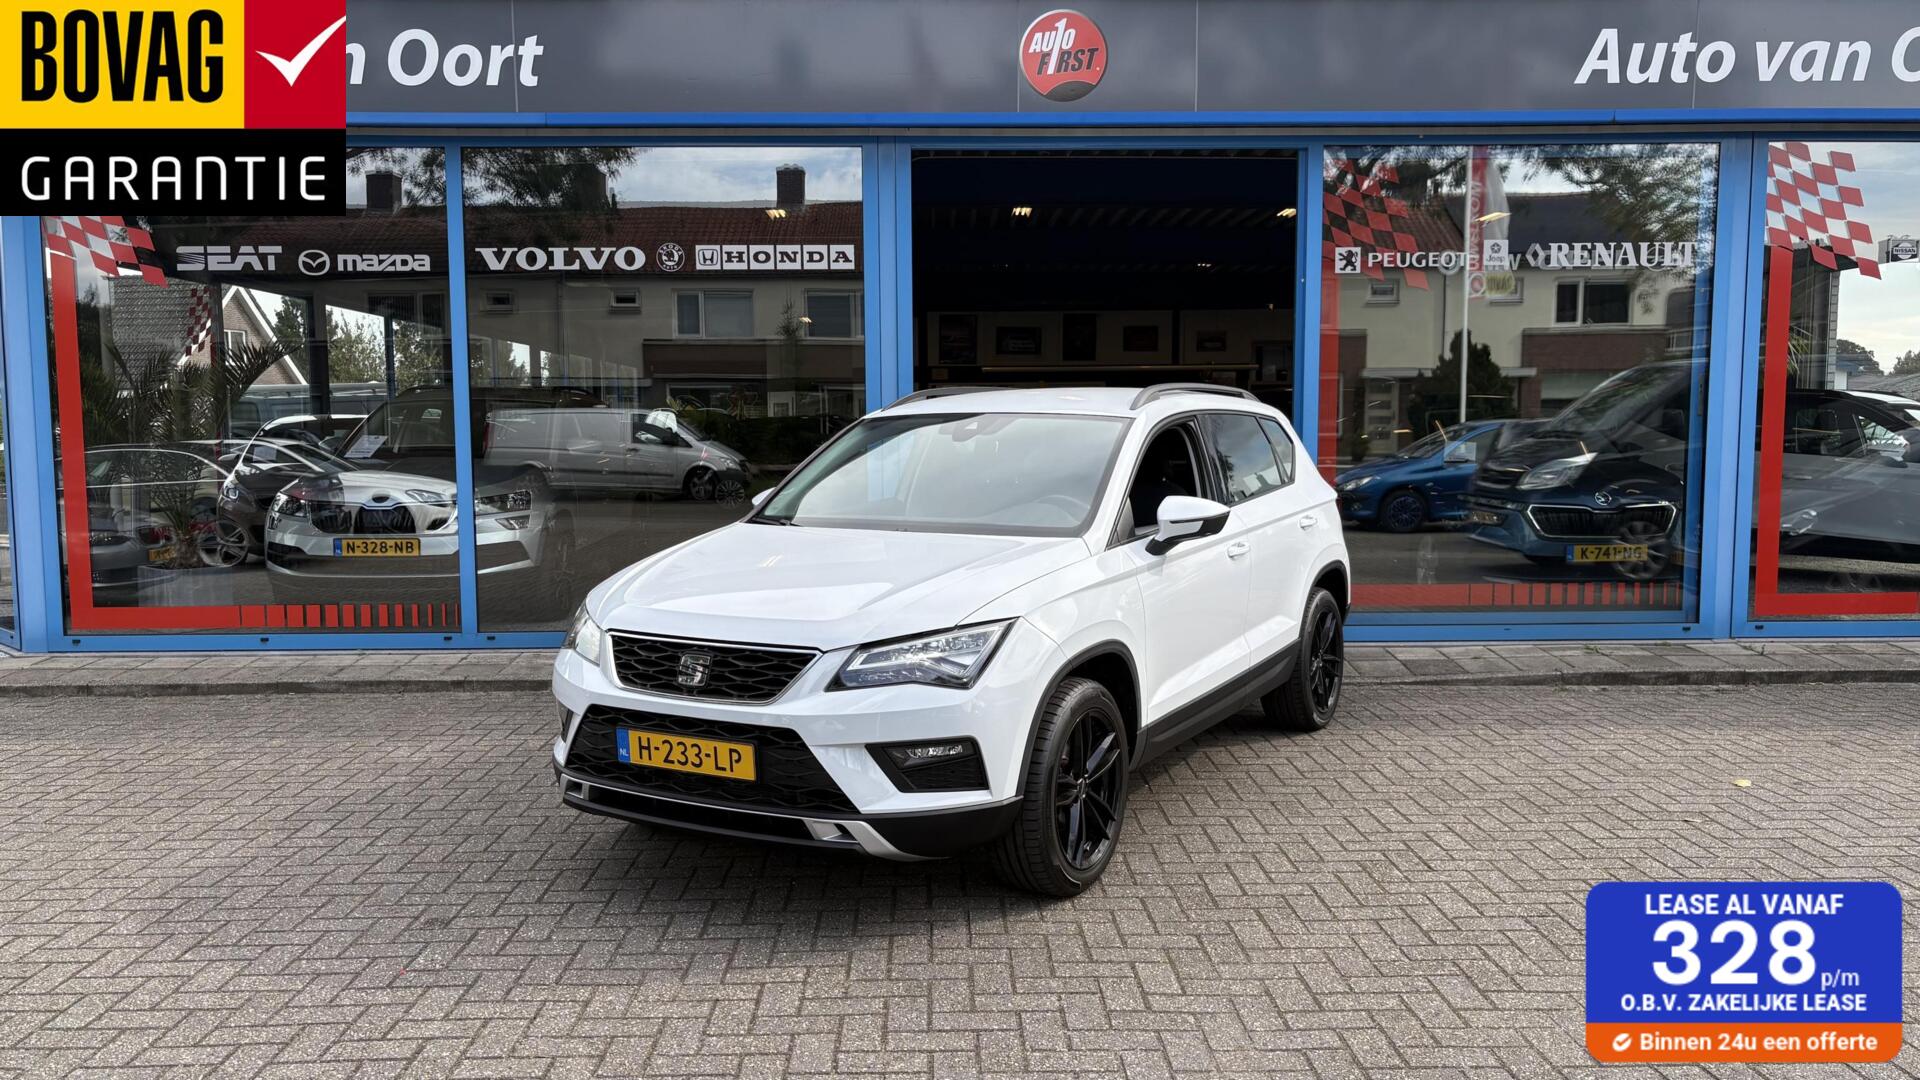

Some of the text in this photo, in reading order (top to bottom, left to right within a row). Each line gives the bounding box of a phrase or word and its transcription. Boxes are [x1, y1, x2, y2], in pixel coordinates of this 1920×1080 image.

[387, 28, 545, 88] Oort
[1574, 28, 1737, 85] Auto
[1754, 39, 1872, 83] van
[176, 245, 283, 272] SEAT
[475, 247, 646, 271] VOLVO
[723, 248, 854, 266] HONDA
[1368, 252, 1469, 269] PEUGEOT
[1549, 242, 1698, 268] RENAULT
[346, 541, 414, 554] N-328-NB
[638, 735, 742, 772] H-233-LP
